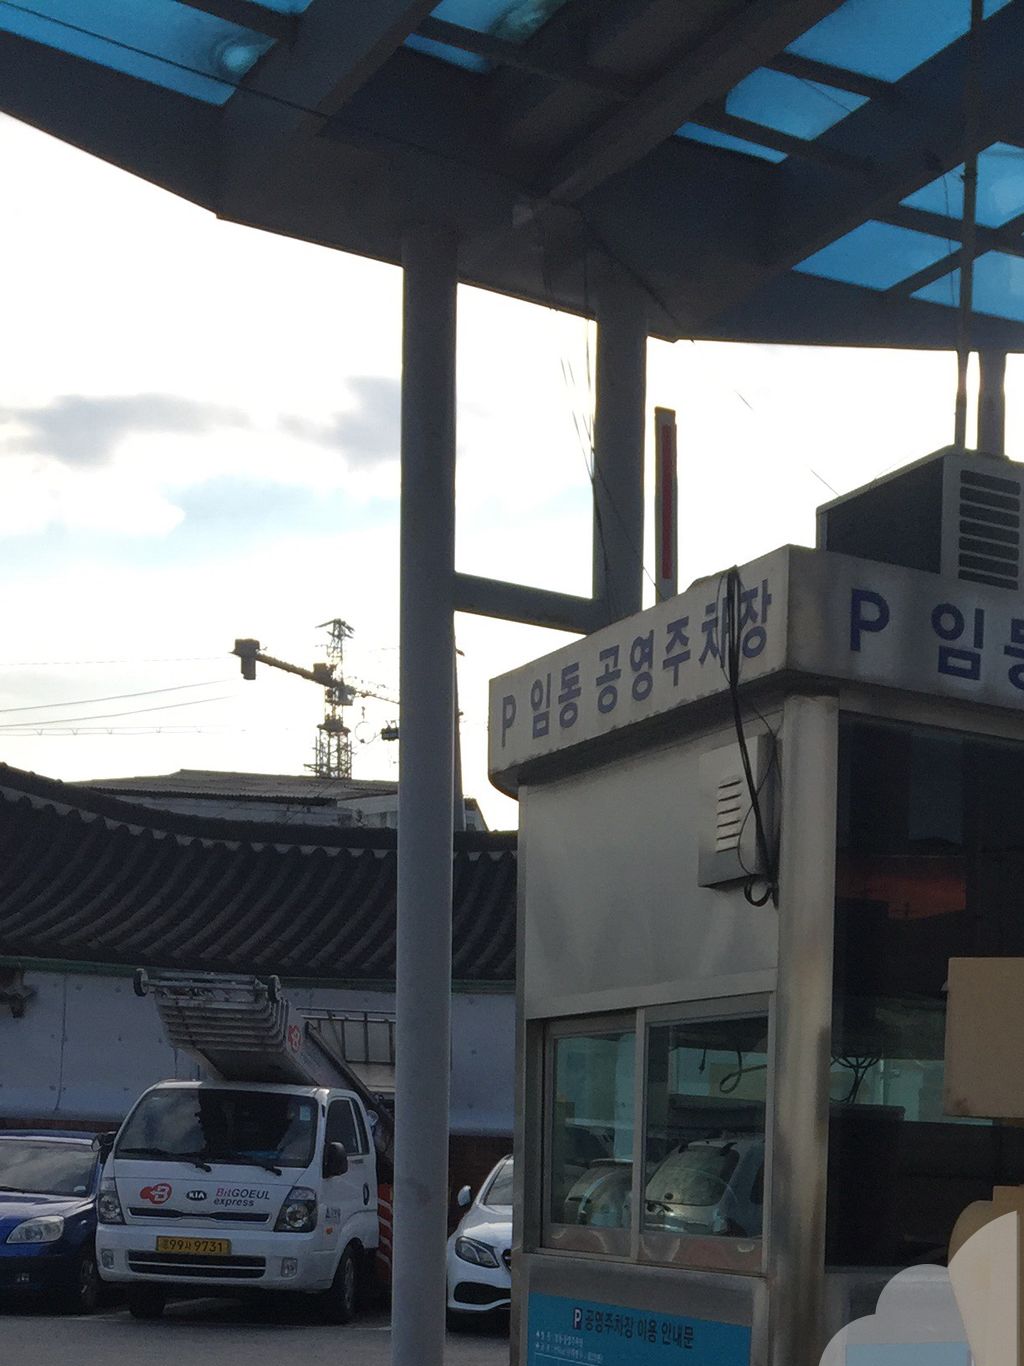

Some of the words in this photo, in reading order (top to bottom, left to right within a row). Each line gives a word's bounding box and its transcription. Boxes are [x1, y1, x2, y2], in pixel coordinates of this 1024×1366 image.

[850, 588, 890, 652] P
[502, 693, 517, 748] P
[530, 662, 581, 740] 임동
[596, 578, 772, 715] 공영주차장
[213, 1198, 256, 1207] express
[216, 1187, 270, 1201] BitGOEUL
[194, 1240, 223, 1252] 9731
[573, 1308, 582, 1329] P
[585, 1309, 634, 1339] 공영주차장
[637, 1319, 657, 1343] 이용
[661, 1322, 694, 1349] 안내문
